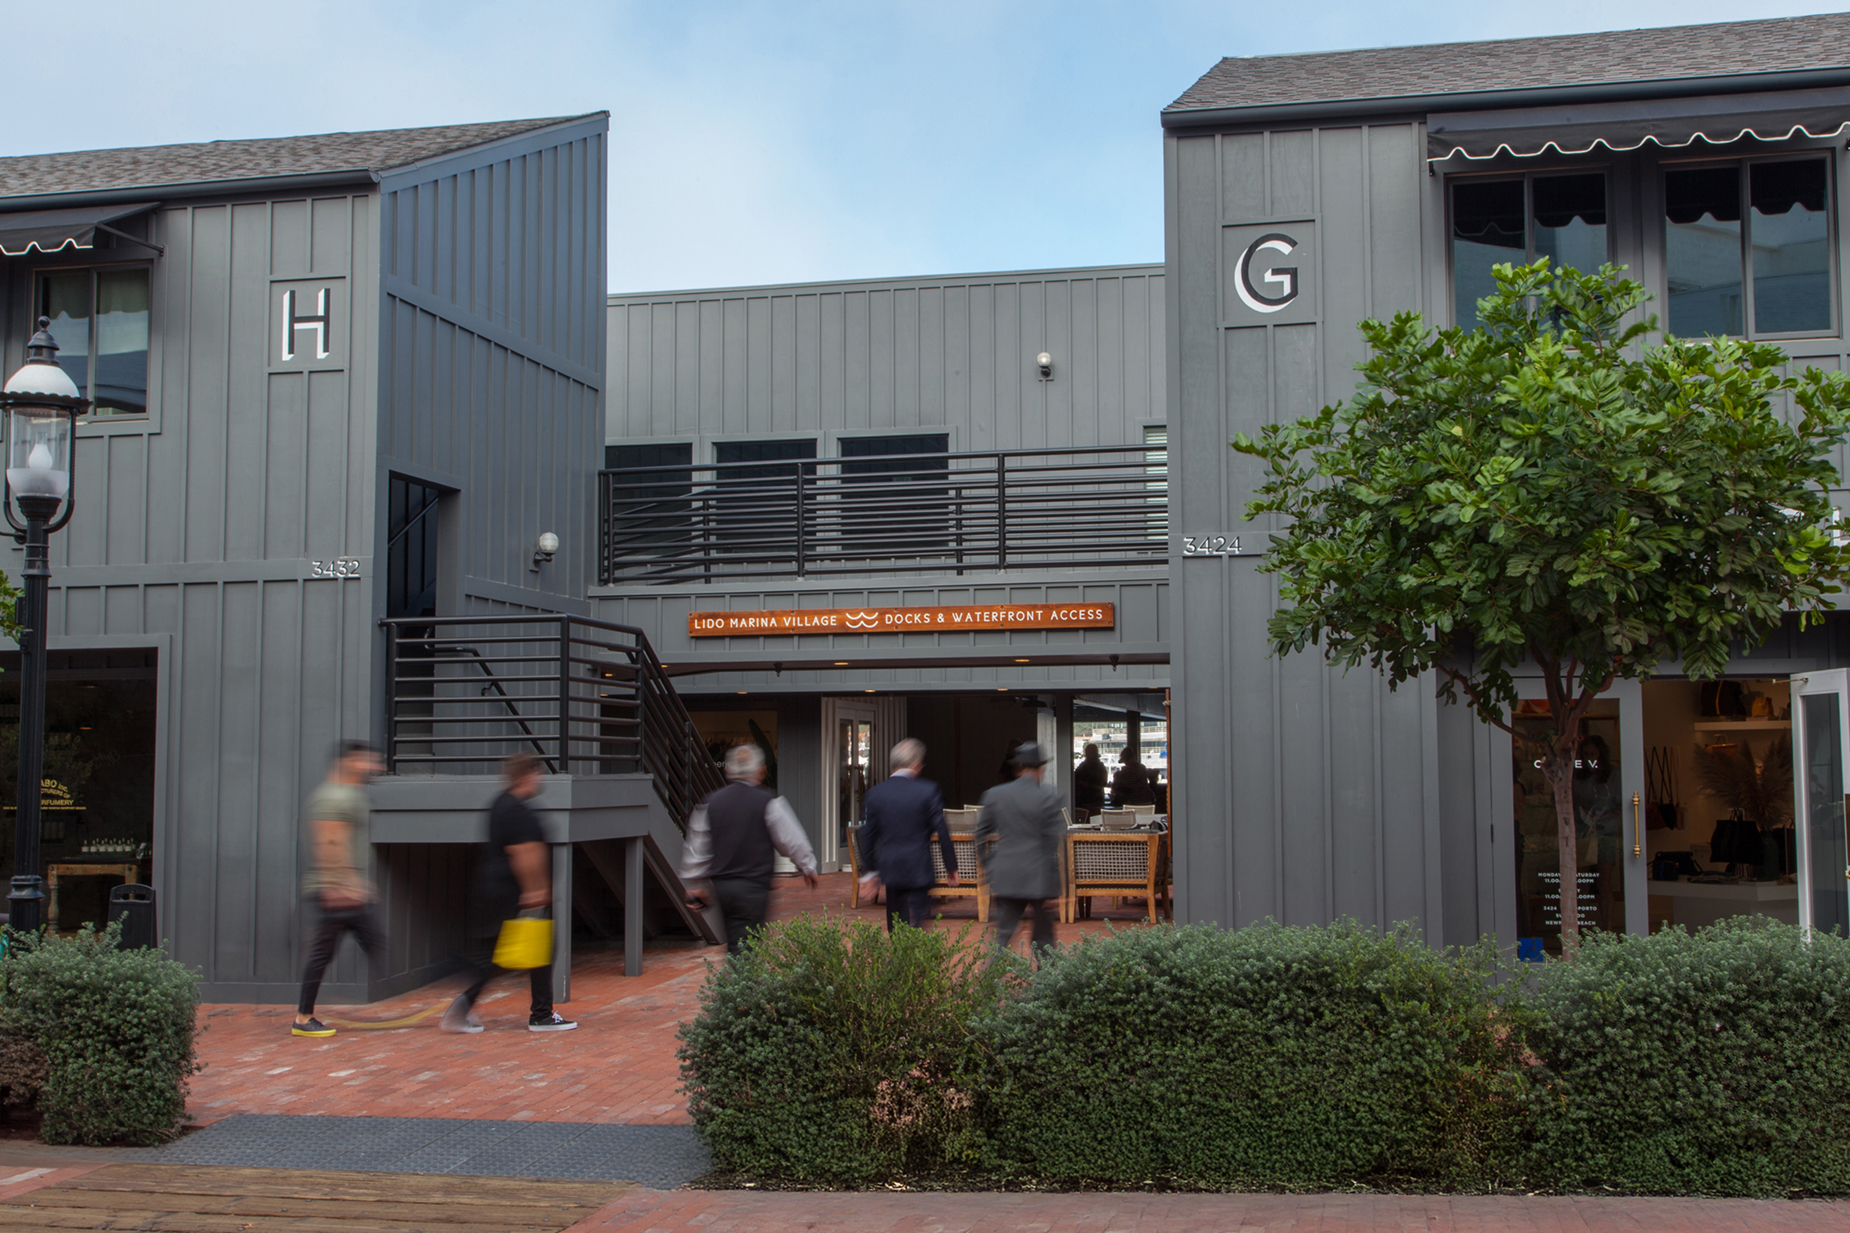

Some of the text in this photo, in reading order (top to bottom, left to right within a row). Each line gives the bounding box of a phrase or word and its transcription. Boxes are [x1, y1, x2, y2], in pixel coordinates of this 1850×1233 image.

[1234, 232, 1299, 313] G
[282, 287, 331, 361] H
[1183, 535, 1242, 555] 3424
[311, 559, 361, 578] 3432
[694, 609, 1103, 629] LIDO MARINA VILLAGE DOCKS & WATERFRONT ACCESS
